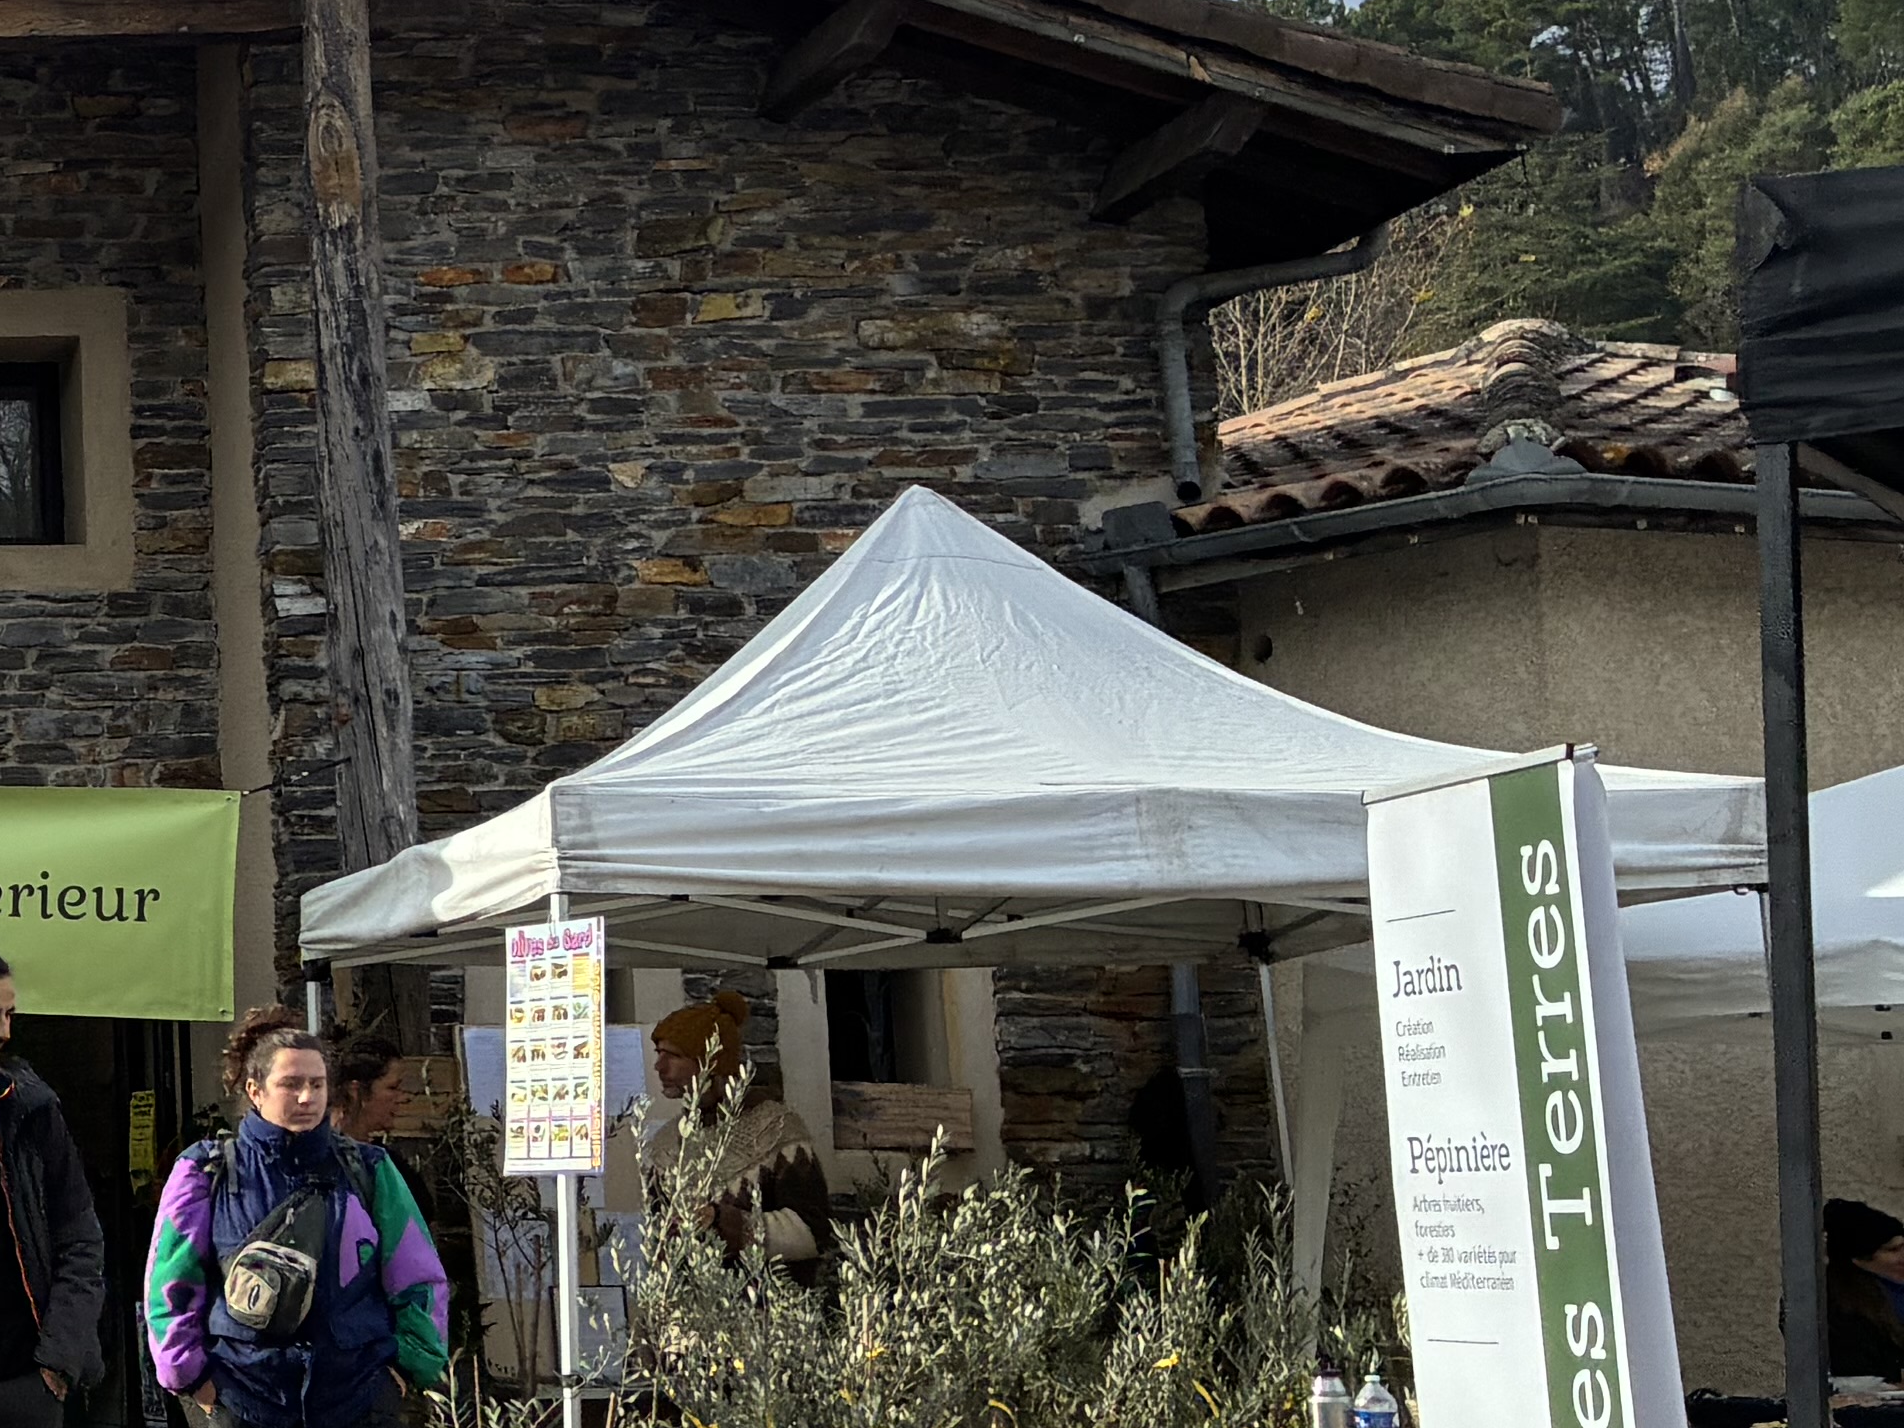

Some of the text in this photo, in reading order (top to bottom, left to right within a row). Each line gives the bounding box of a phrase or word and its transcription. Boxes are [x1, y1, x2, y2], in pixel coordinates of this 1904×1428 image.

[1392, 955, 1463, 999] Jardin
[1520, 838, 1593, 1251] Terres
[1407, 1130, 1511, 1184] Pépinière
